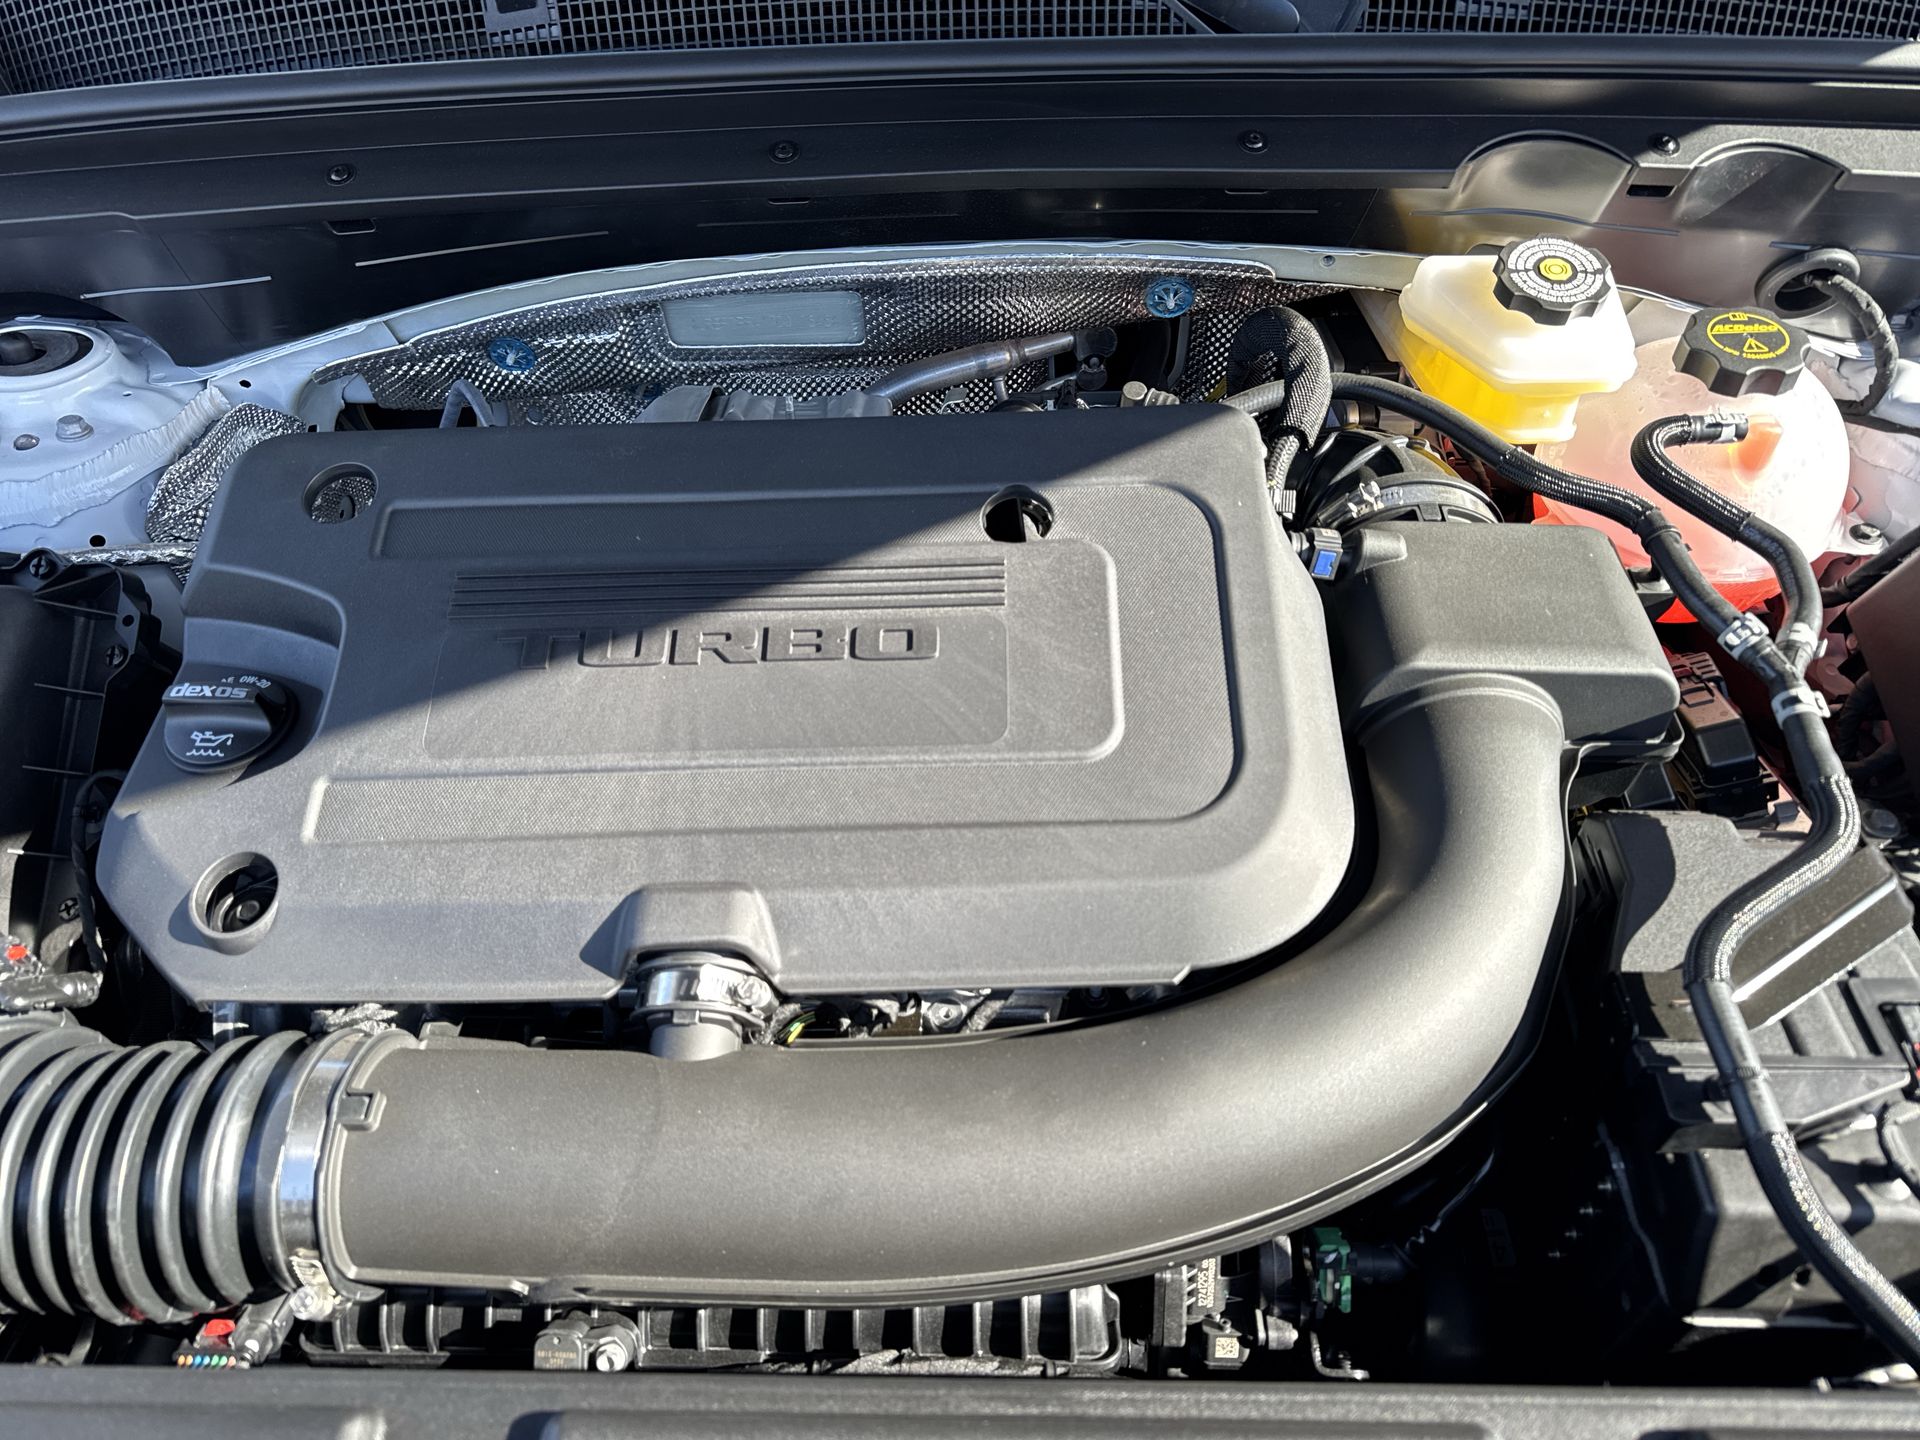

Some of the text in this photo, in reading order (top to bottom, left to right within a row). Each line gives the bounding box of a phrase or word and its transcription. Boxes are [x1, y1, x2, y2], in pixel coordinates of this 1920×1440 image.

[1712, 323, 1777, 334] ACDelco
[497, 625, 940, 670] TURBO
[170, 683, 249, 698] dexos
